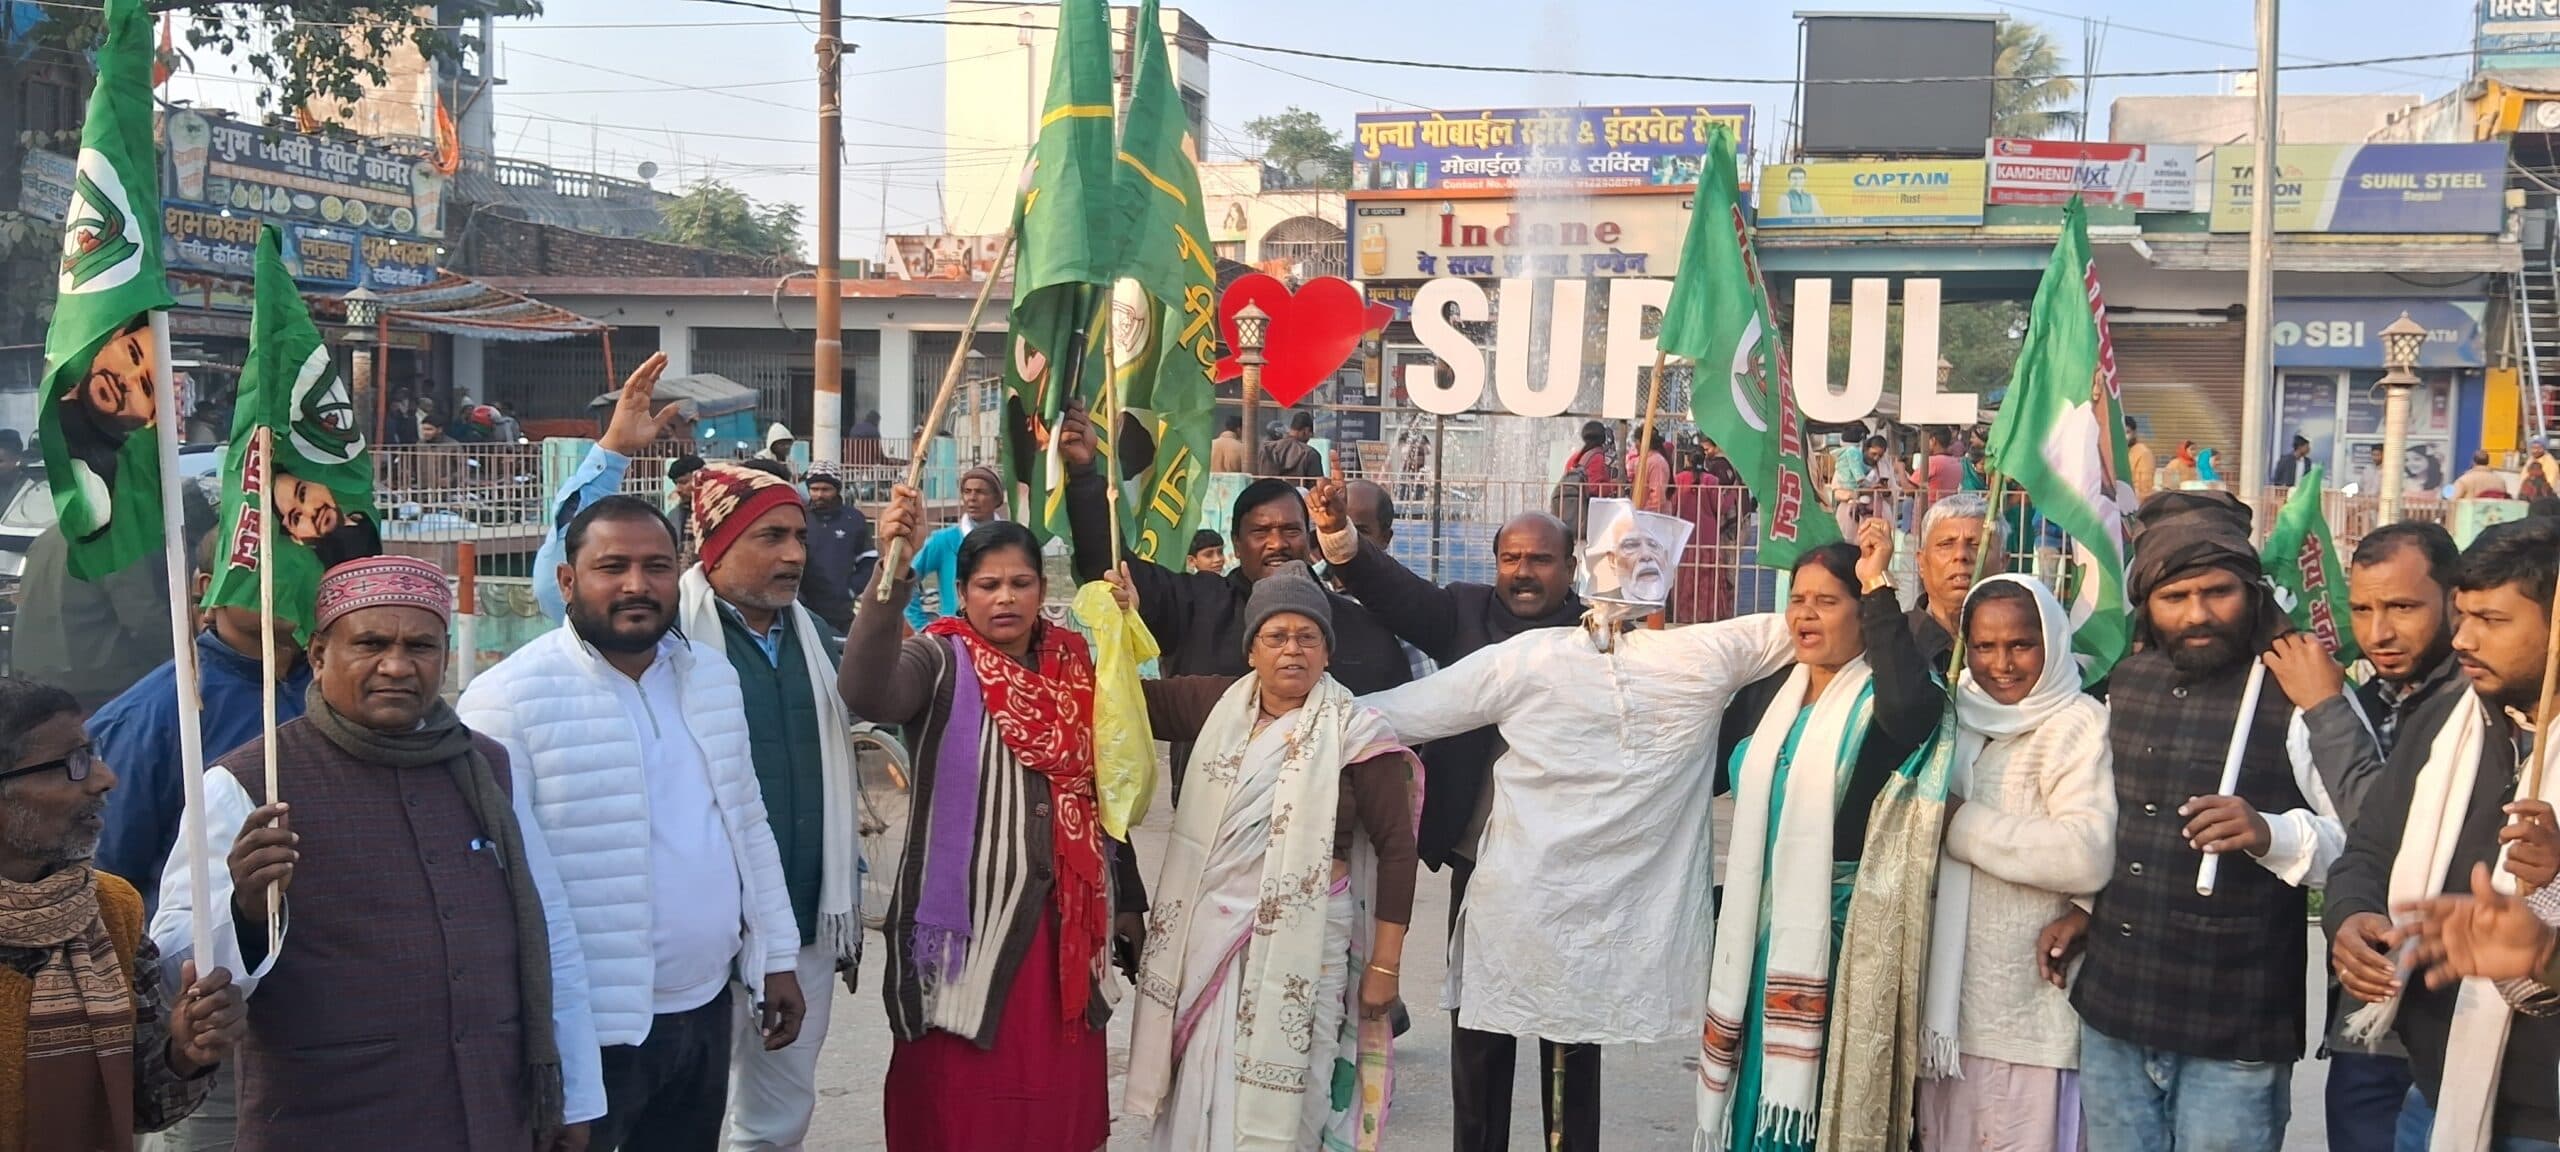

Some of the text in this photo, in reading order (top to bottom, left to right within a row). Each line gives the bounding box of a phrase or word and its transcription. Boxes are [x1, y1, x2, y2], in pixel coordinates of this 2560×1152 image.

[1358, 121, 1417, 160] मुन्ना
[1419, 111, 1516, 150] मोबाईल
[1576, 120, 1596, 145] &
[1602, 107, 1688, 150] इंटरनेट
[212, 125, 251, 161] शुभ
[258, 133, 313, 168] लक्ष्मी
[318, 141, 360, 174] स्वीट
[364, 148, 412, 186] कॉर्नर
[1440, 152, 1522, 177] मोबाईल
[1569, 158, 1582, 173] &
[1587, 151, 1651, 173] सर्विस
[1853, 172, 1950, 187] CAPTAIN
[1997, 163, 2112, 188] KAMDHENU Nxt
[2360, 173, 2486, 190] SUNIL STEEL
[165, 207, 203, 242] शुभ
[204, 214, 261, 244] लक्ष्मी
[1438, 213, 1622, 248] Indane
[2305, 320, 2365, 348] SBI
[2427, 330, 2458, 342] ATM
[1405, 277, 1978, 426] SUPUL
